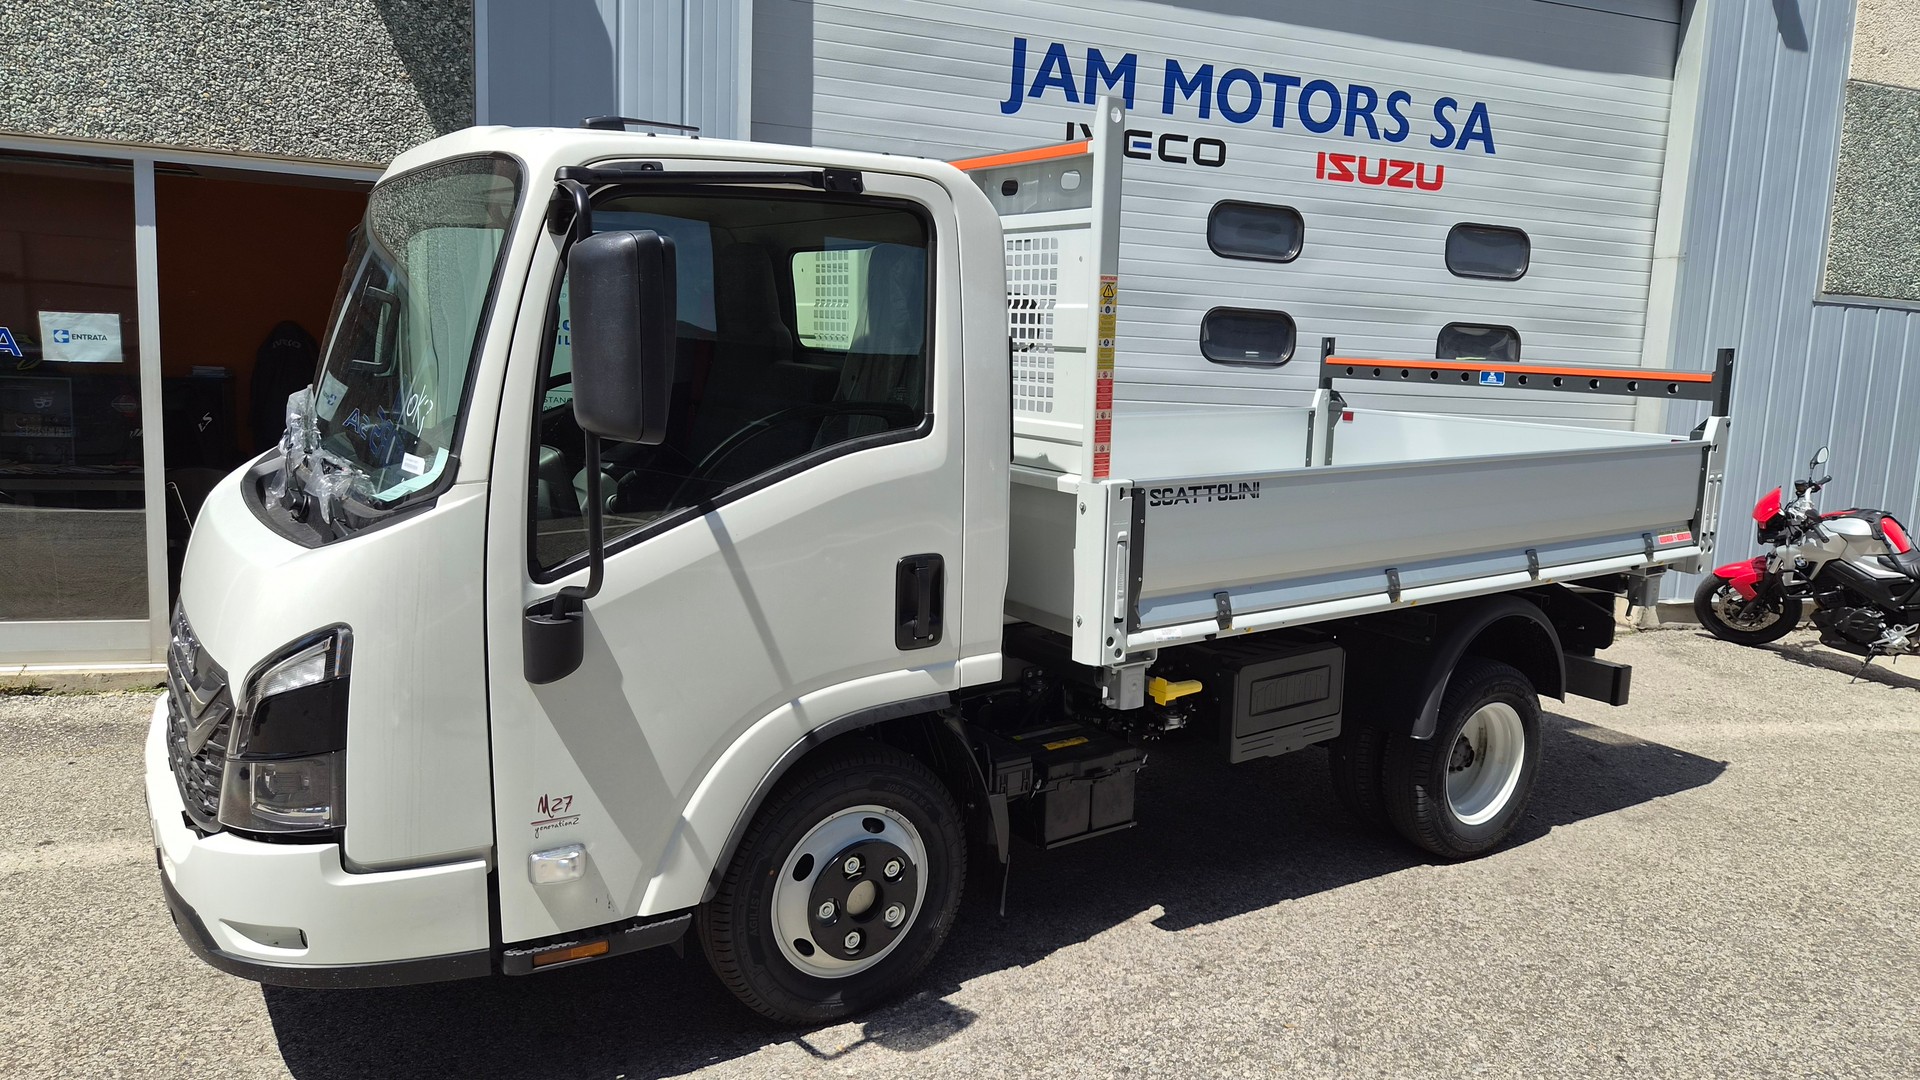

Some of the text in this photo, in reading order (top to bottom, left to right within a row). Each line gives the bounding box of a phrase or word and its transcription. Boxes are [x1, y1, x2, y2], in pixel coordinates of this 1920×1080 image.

[1000, 38, 1497, 156] JAM MOTORS SA
[1065, 121, 1228, 169] IECO
[1316, 152, 1445, 193] ISUZU
[71, 333, 108, 341] ENTRATA
[1149, 481, 1261, 507] SCATTOLINI
[537, 793, 573, 818] M27
[534, 816, 580, 839] generation2
[748, 897, 760, 937] AGILIS
